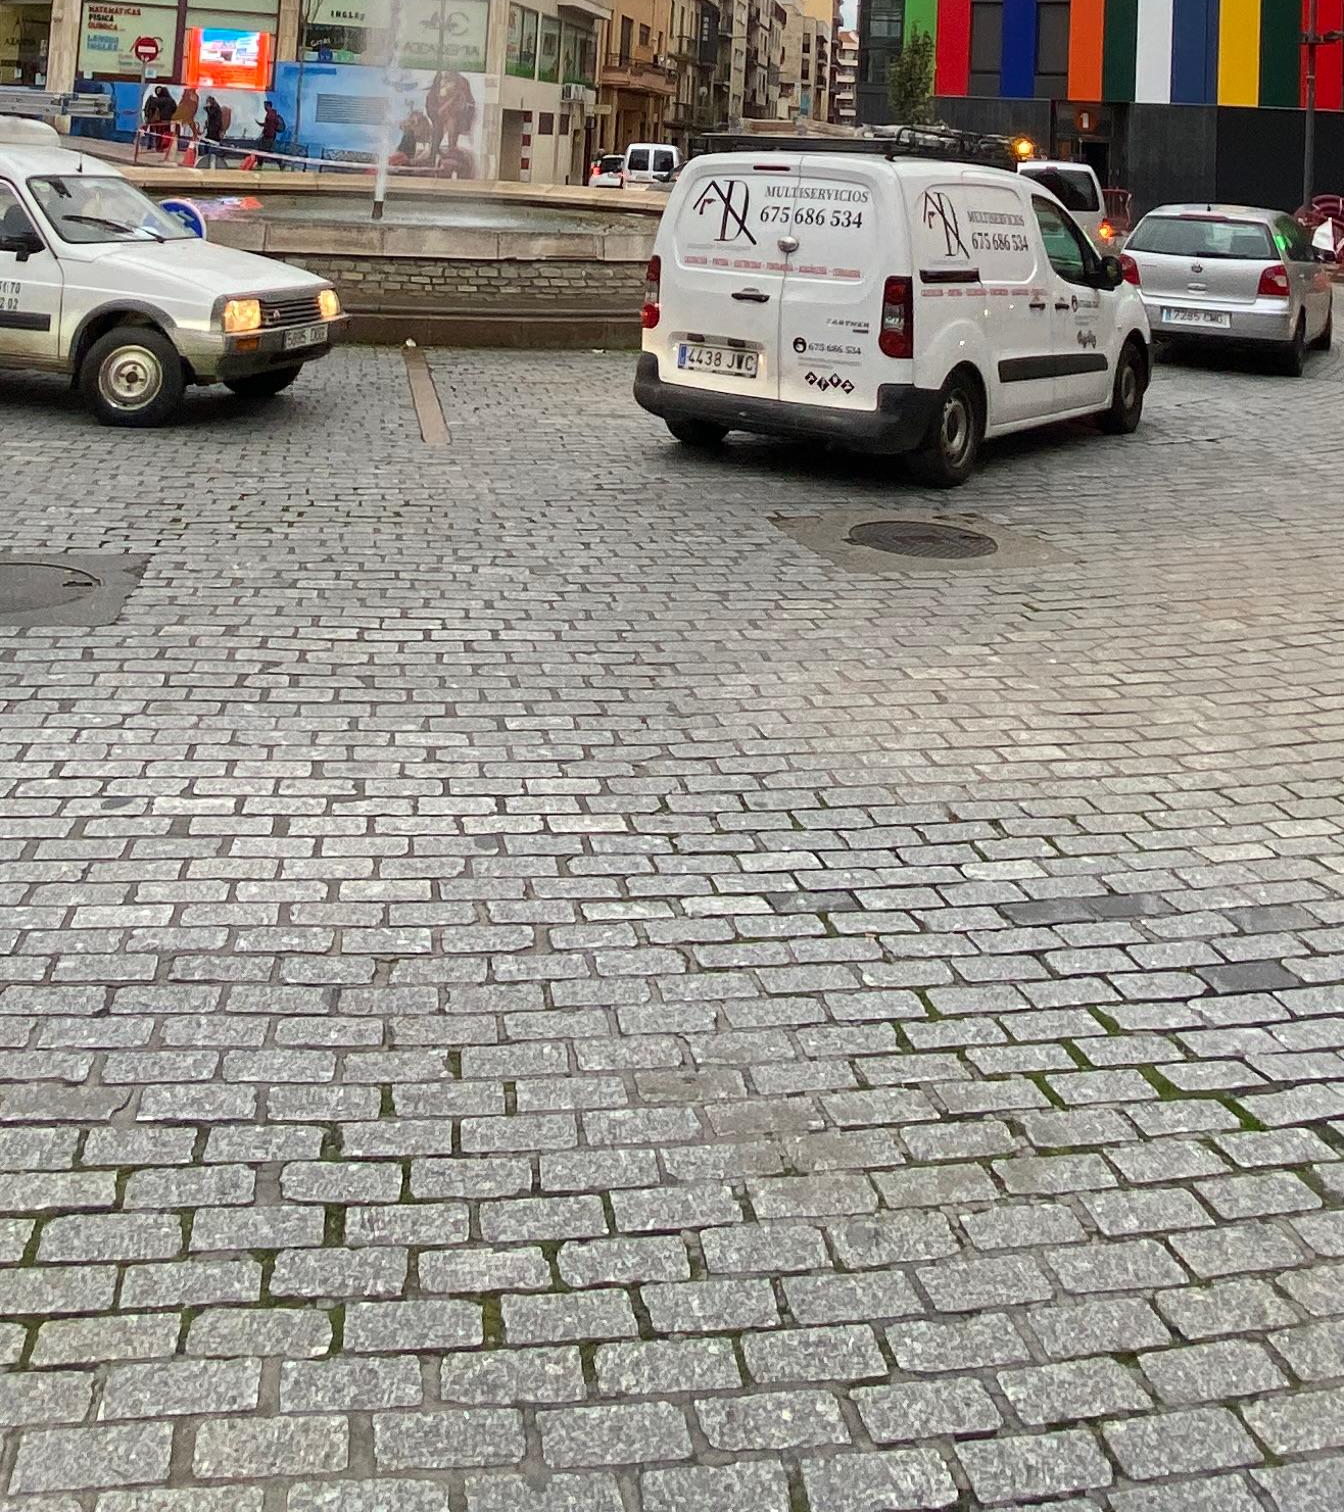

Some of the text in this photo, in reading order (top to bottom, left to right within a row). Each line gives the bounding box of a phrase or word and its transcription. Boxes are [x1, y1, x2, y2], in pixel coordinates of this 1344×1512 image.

[1080, 112, 1090, 129] 1
[764, 185, 871, 203] MULTISERVICIOS
[760, 205, 863, 229] 675 686 534
[971, 232, 1029, 252] 675 686 534
[688, 348, 723, 367] 4438
